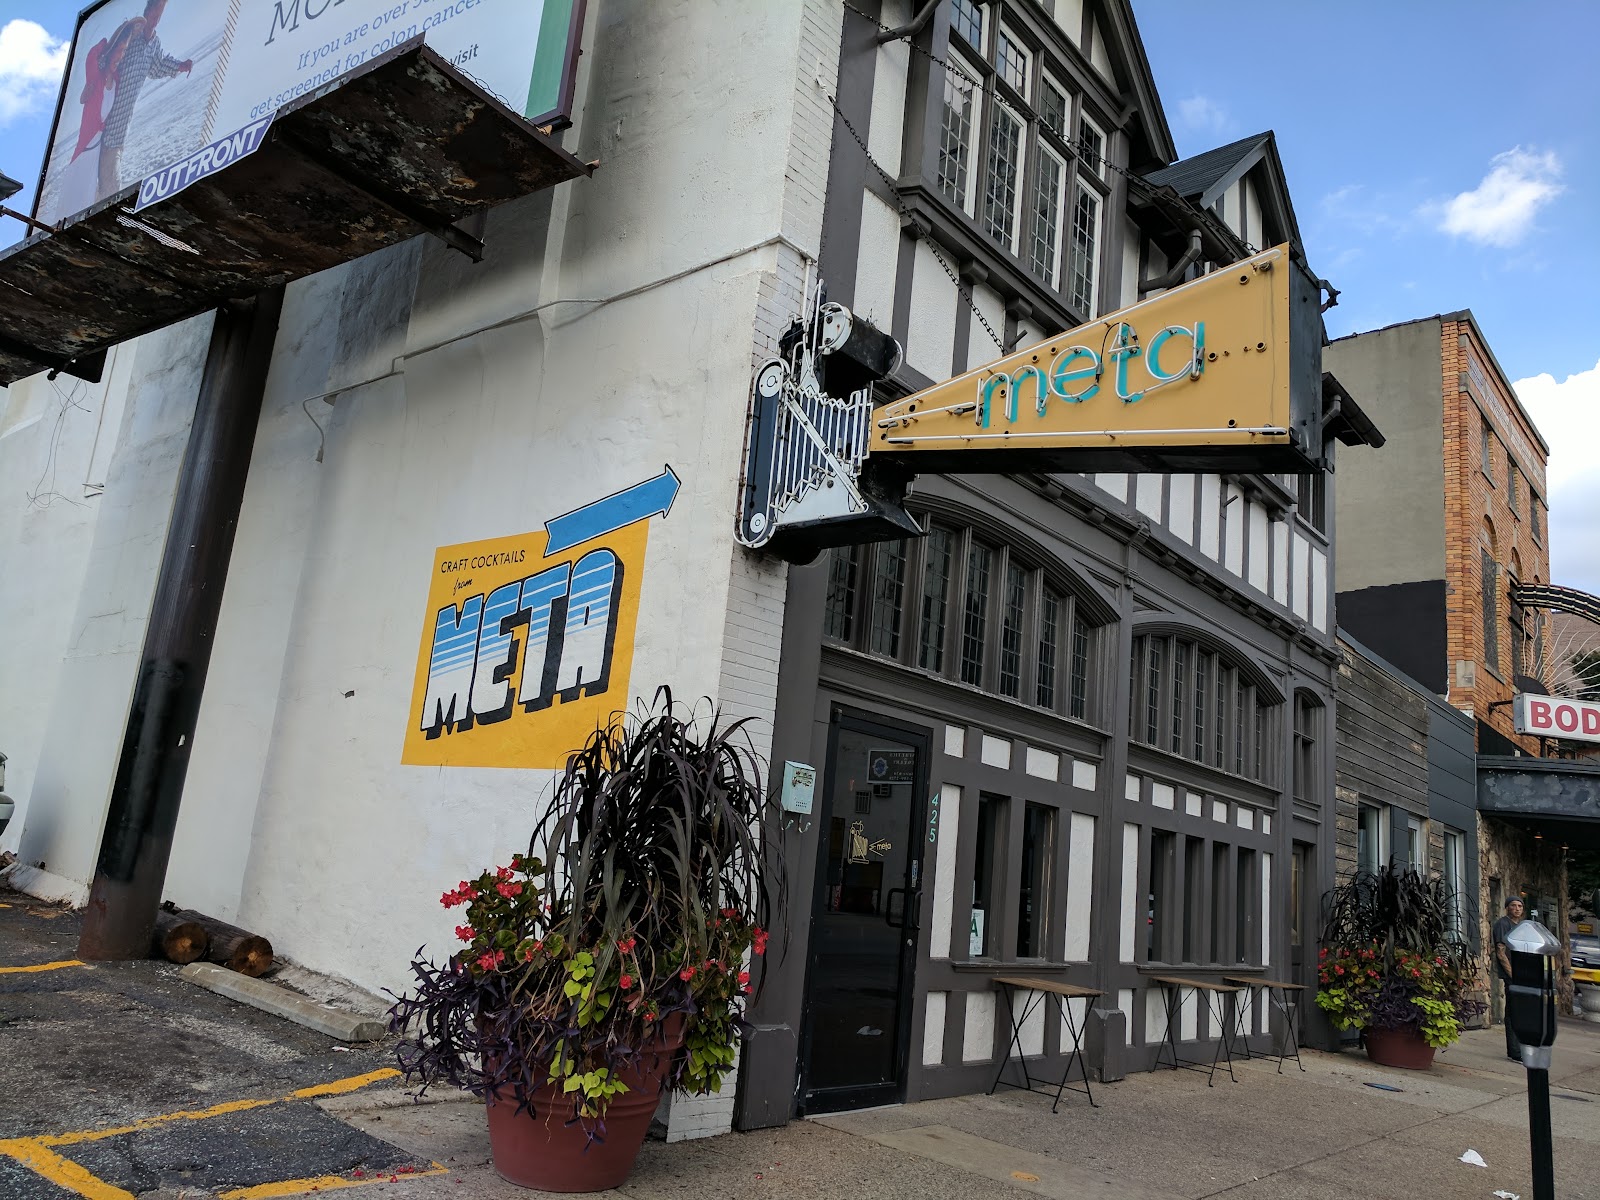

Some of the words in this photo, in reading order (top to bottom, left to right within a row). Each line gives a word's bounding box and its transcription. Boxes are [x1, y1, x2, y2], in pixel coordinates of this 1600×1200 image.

[250, 97, 272, 119] get
[274, 59, 341, 107] screened
[343, 49, 367, 72] for
[371, 24, 417, 57] colon
[297, 50, 310, 71] If
[311, 38, 340, 67] you
[343, 23, 369, 46] are
[372, 0, 409, 30] over
[450, 43, 479, 66] visit
[141, 118, 271, 204] OUTFRONT
[974, 320, 1206, 428] meta
[441, 558, 468, 573] CRAFT
[471, 549, 526, 569] COCKTAILS
[453, 577, 473, 596] from
[420, 547, 624, 740] META
